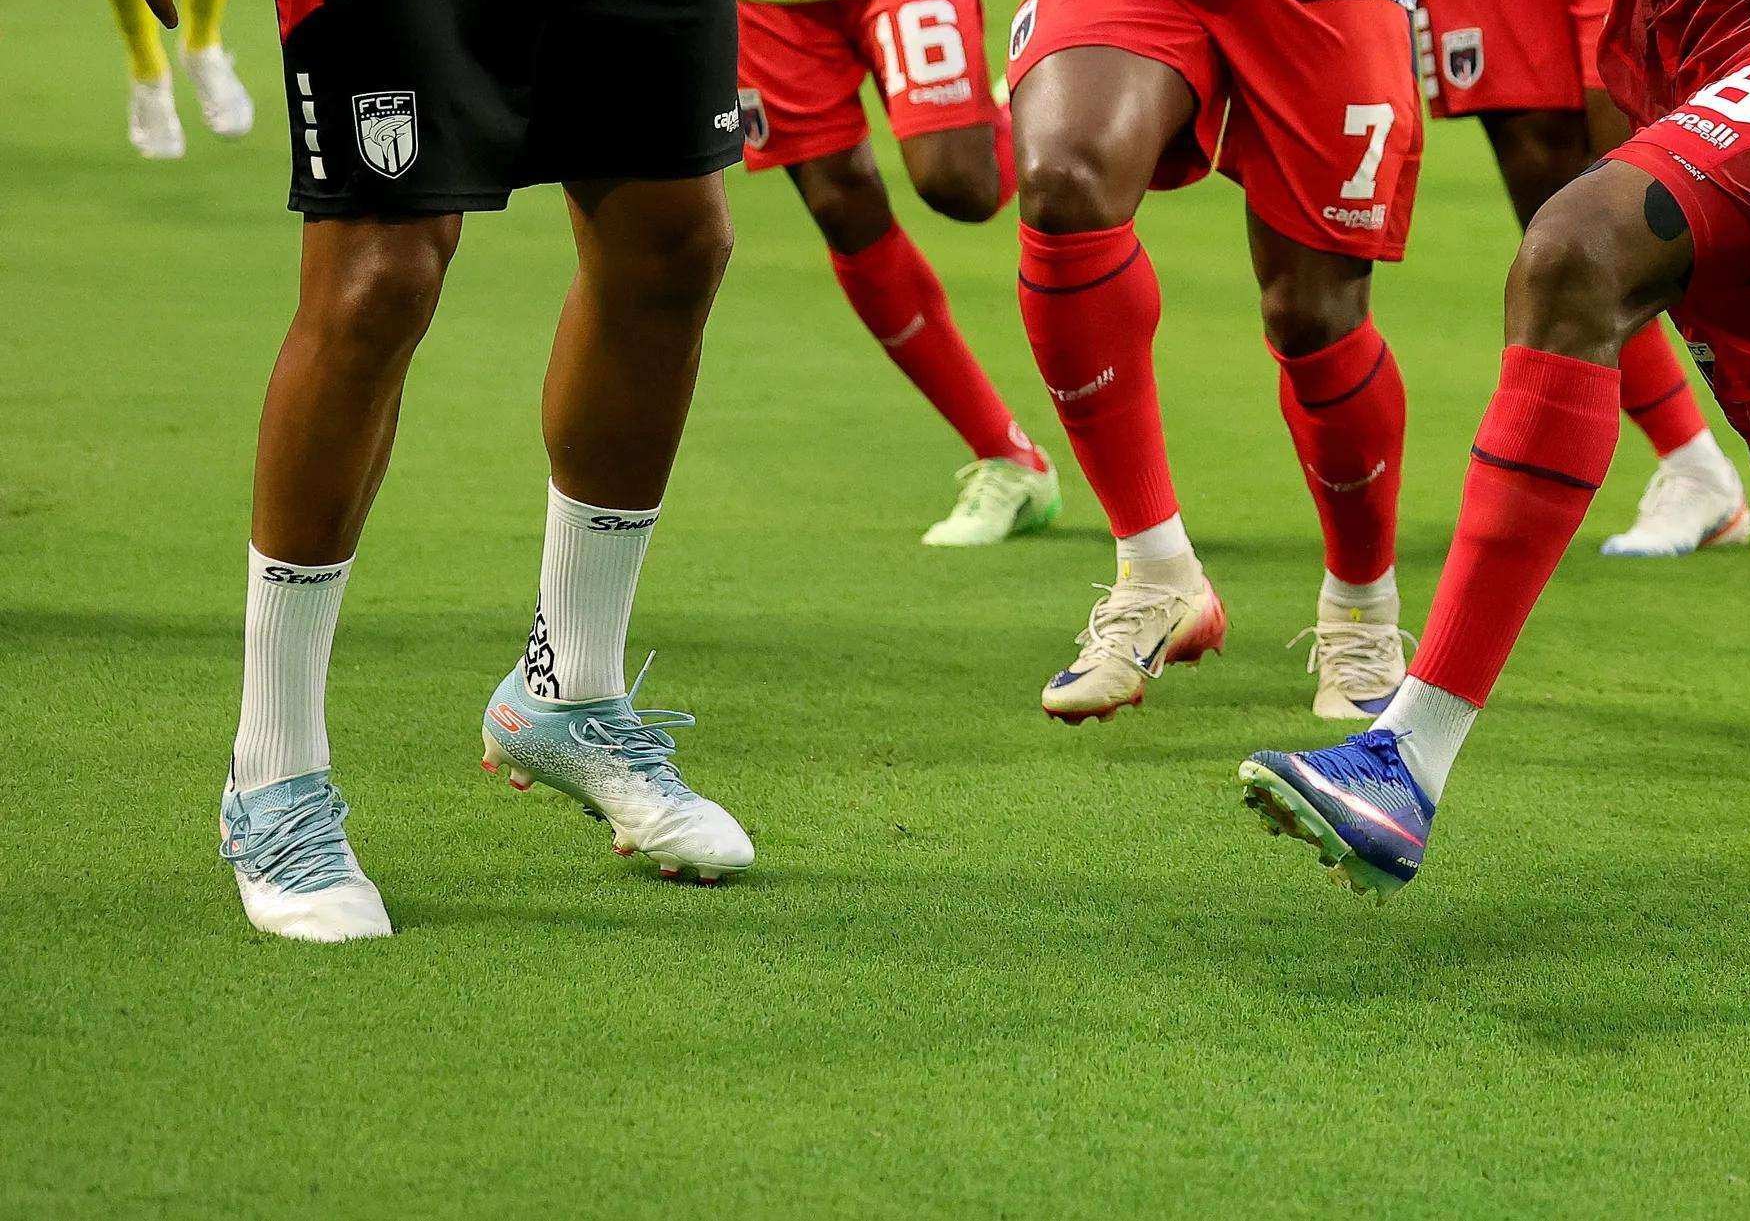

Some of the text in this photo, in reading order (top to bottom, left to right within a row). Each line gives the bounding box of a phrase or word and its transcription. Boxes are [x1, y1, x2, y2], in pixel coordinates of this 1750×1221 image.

[359, 96, 410, 113] FCF
[1683, 123, 1727, 151] SPORT
[1340, 103, 1396, 200] 7
